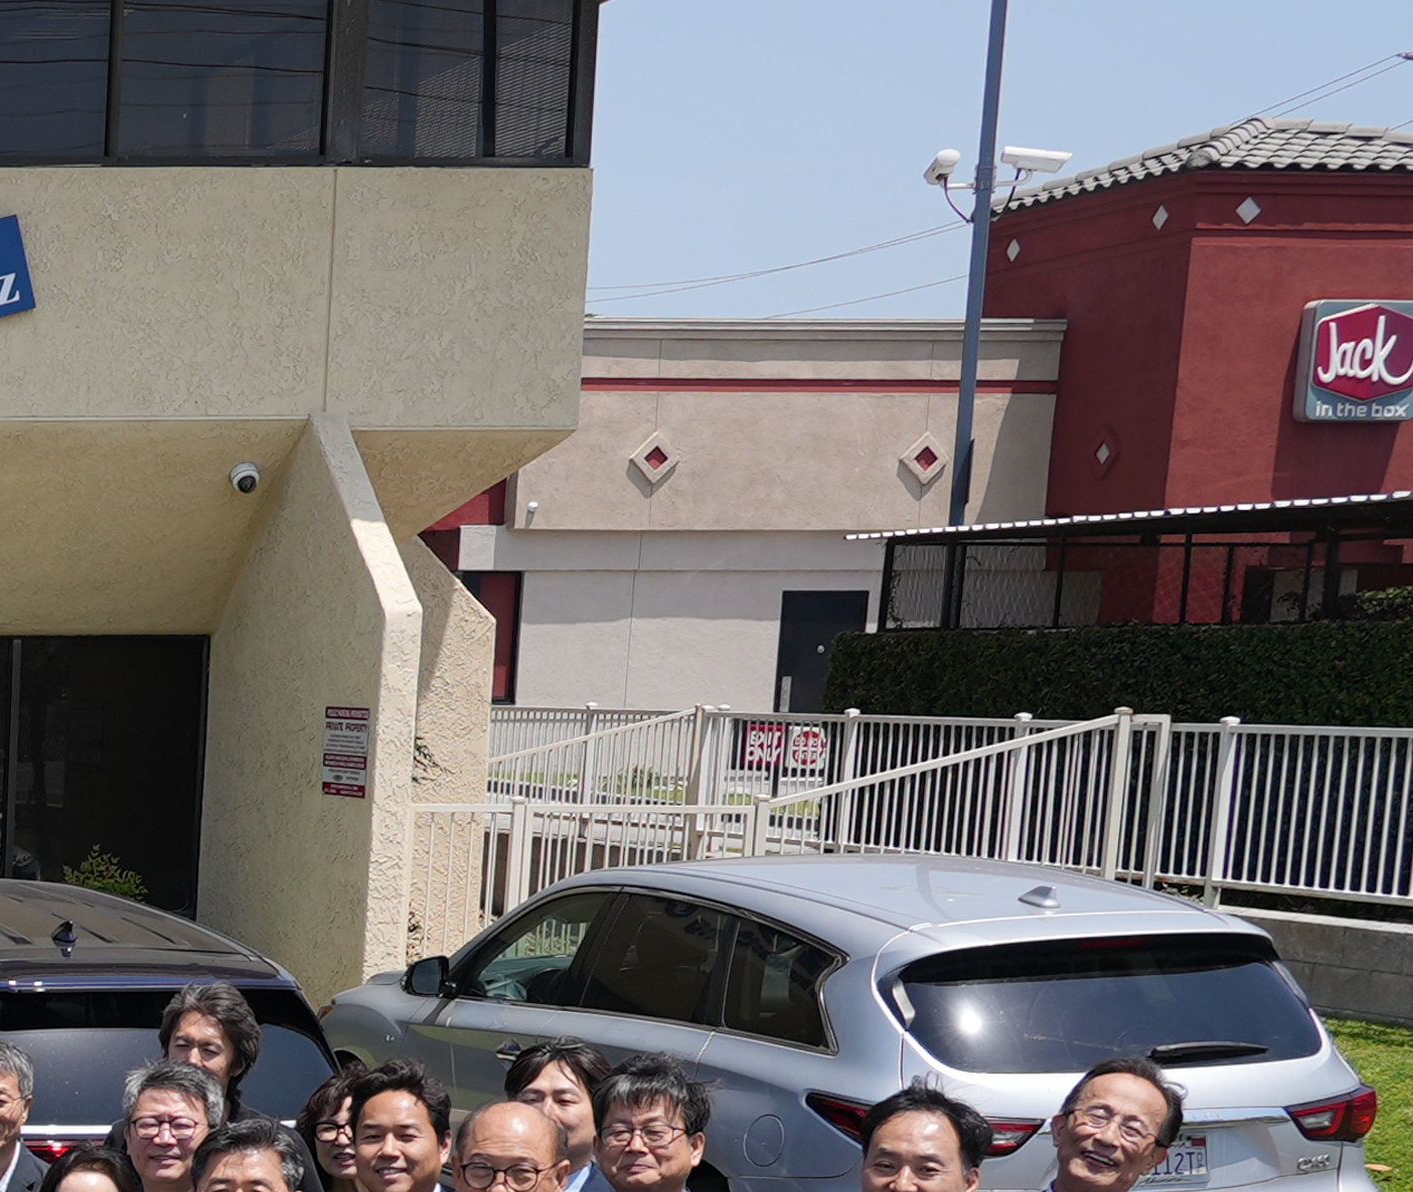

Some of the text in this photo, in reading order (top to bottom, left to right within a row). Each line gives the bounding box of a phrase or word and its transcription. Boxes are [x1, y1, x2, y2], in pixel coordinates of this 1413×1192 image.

[1316, 314, 1413, 386] Jack
[1315, 401, 1411, 418] in the box
